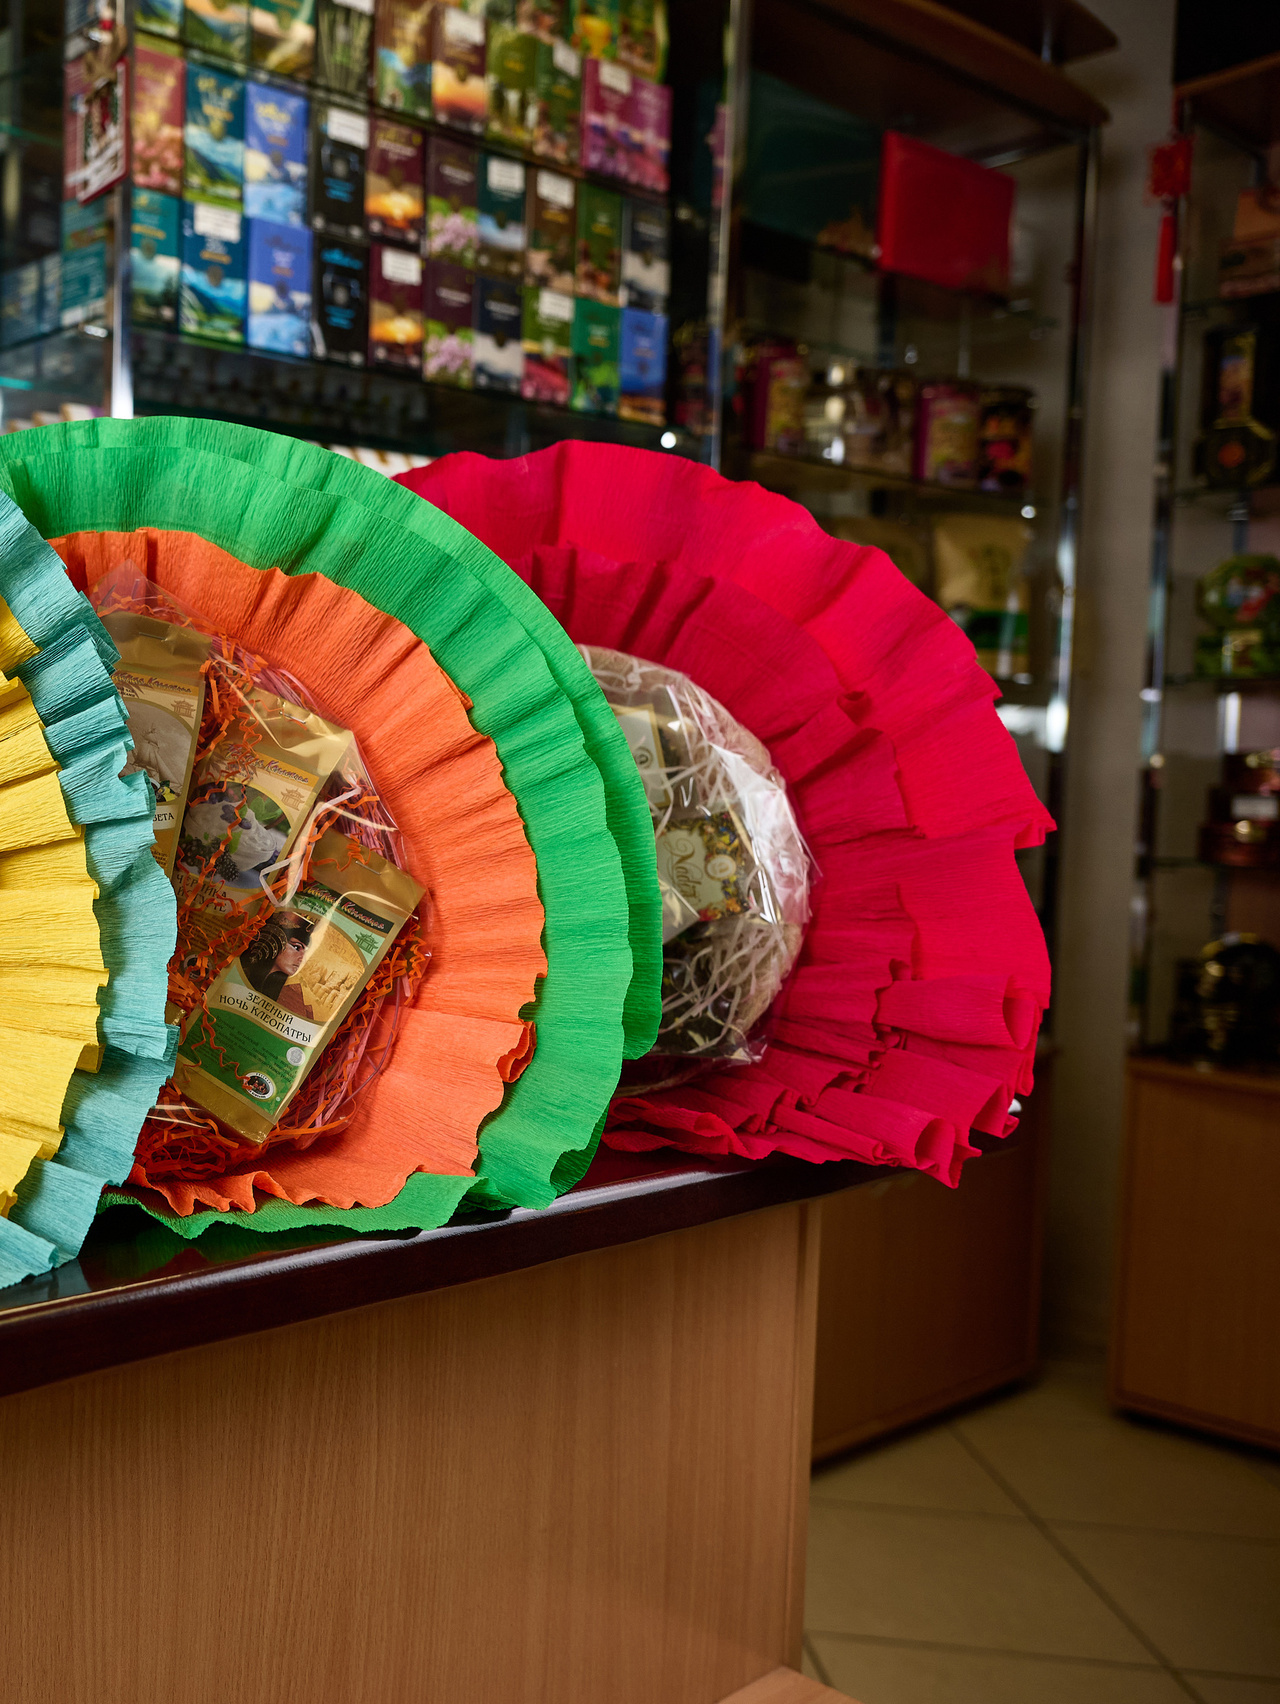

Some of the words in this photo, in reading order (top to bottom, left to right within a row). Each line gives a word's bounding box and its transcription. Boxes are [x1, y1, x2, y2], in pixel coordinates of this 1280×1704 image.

[341, 901, 385, 930] Коллекция
[219, 994, 249, 1011] НОЧЬ
[250, 1005, 312, 1043] КЛЕОПАТРЫ
[246, 992, 294, 1025] ЗЕЛЕНЫЙ
